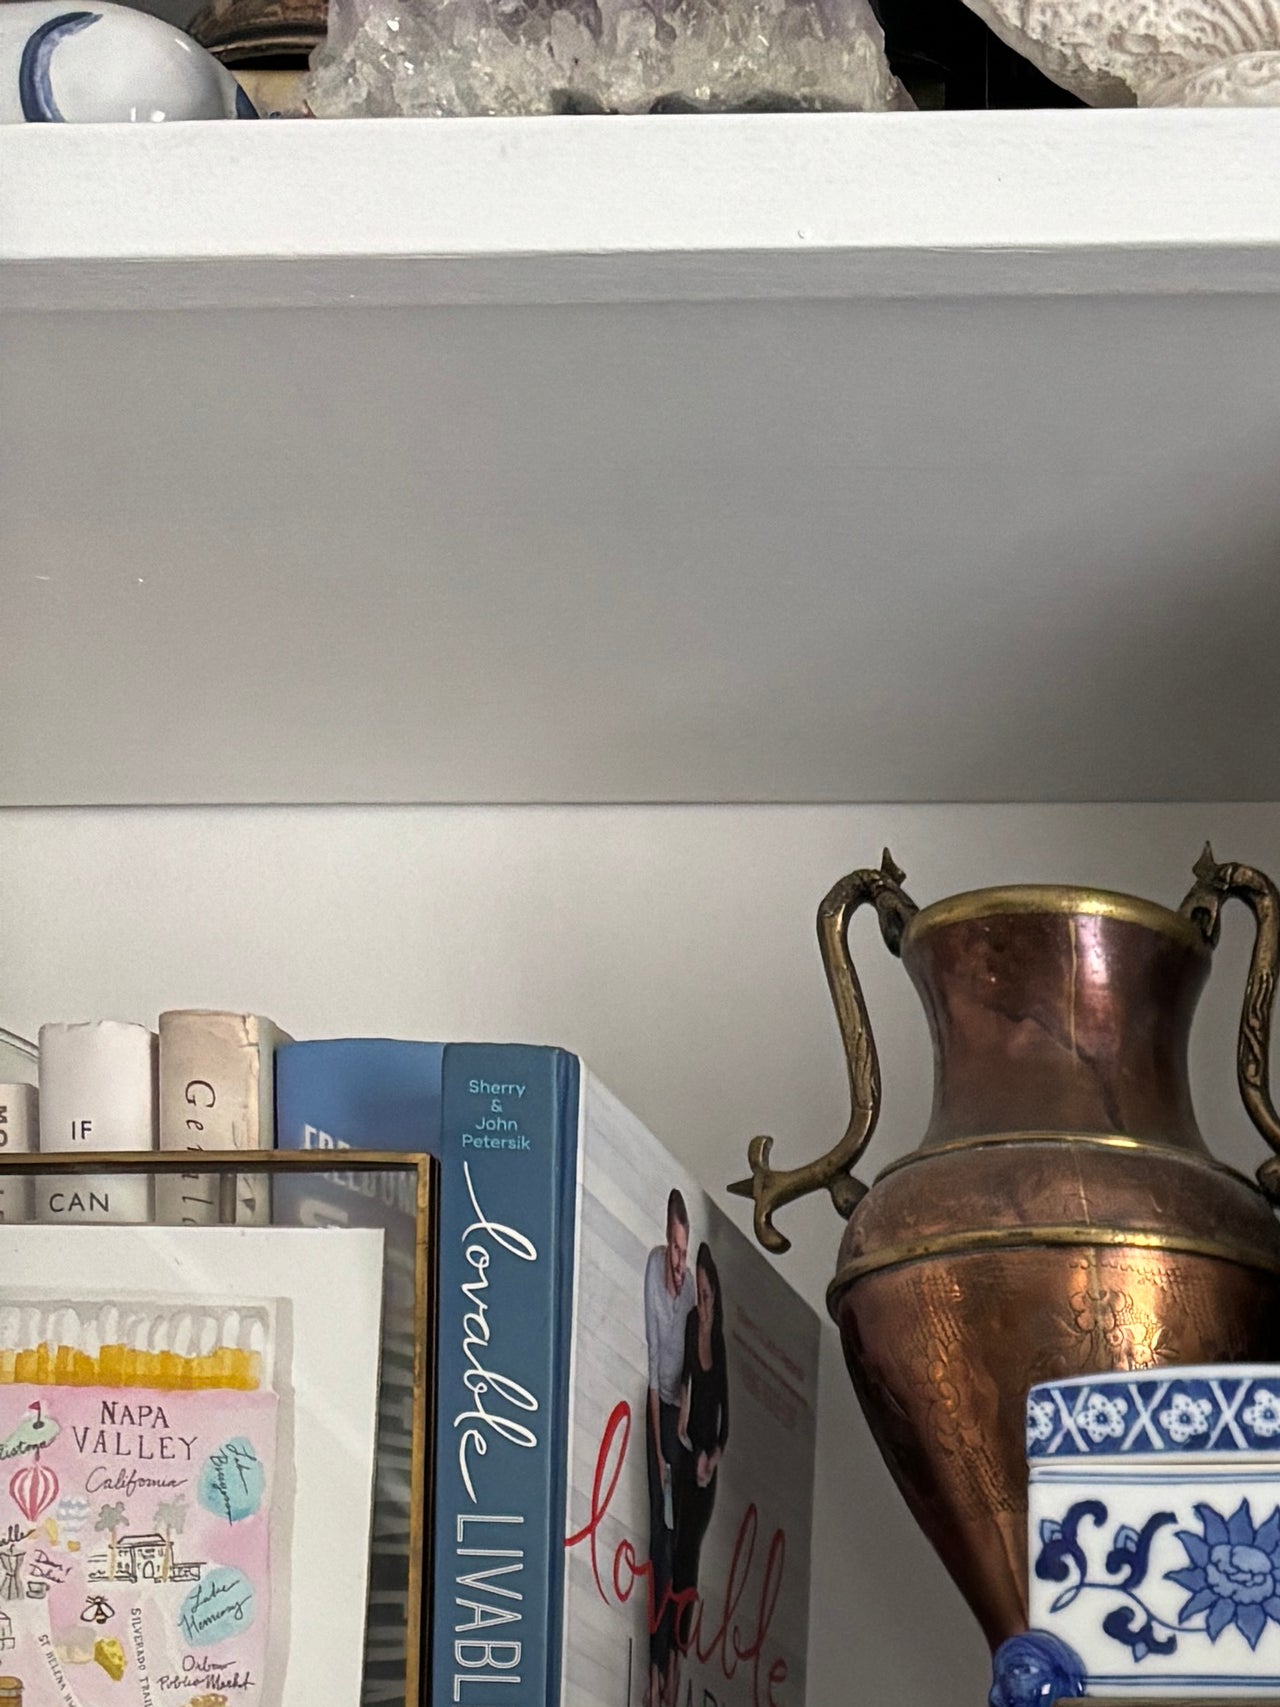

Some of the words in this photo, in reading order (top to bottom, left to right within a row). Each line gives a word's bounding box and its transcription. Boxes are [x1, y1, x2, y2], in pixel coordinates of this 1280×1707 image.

[468, 1079, 526, 1098] Sherry
[491, 1098, 503, 1113] &
[71, 1120, 92, 1141] IF
[475, 1116, 518, 1132] John
[461, 1133, 531, 1151] Petersik
[49, 1192, 109, 1213] CAN
[454, 1160, 539, 1504] lovable
[101, 1400, 170, 1429] NAPA
[72, 1425, 198, 1461] VALLEY
[85, 1465, 189, 1498] California
